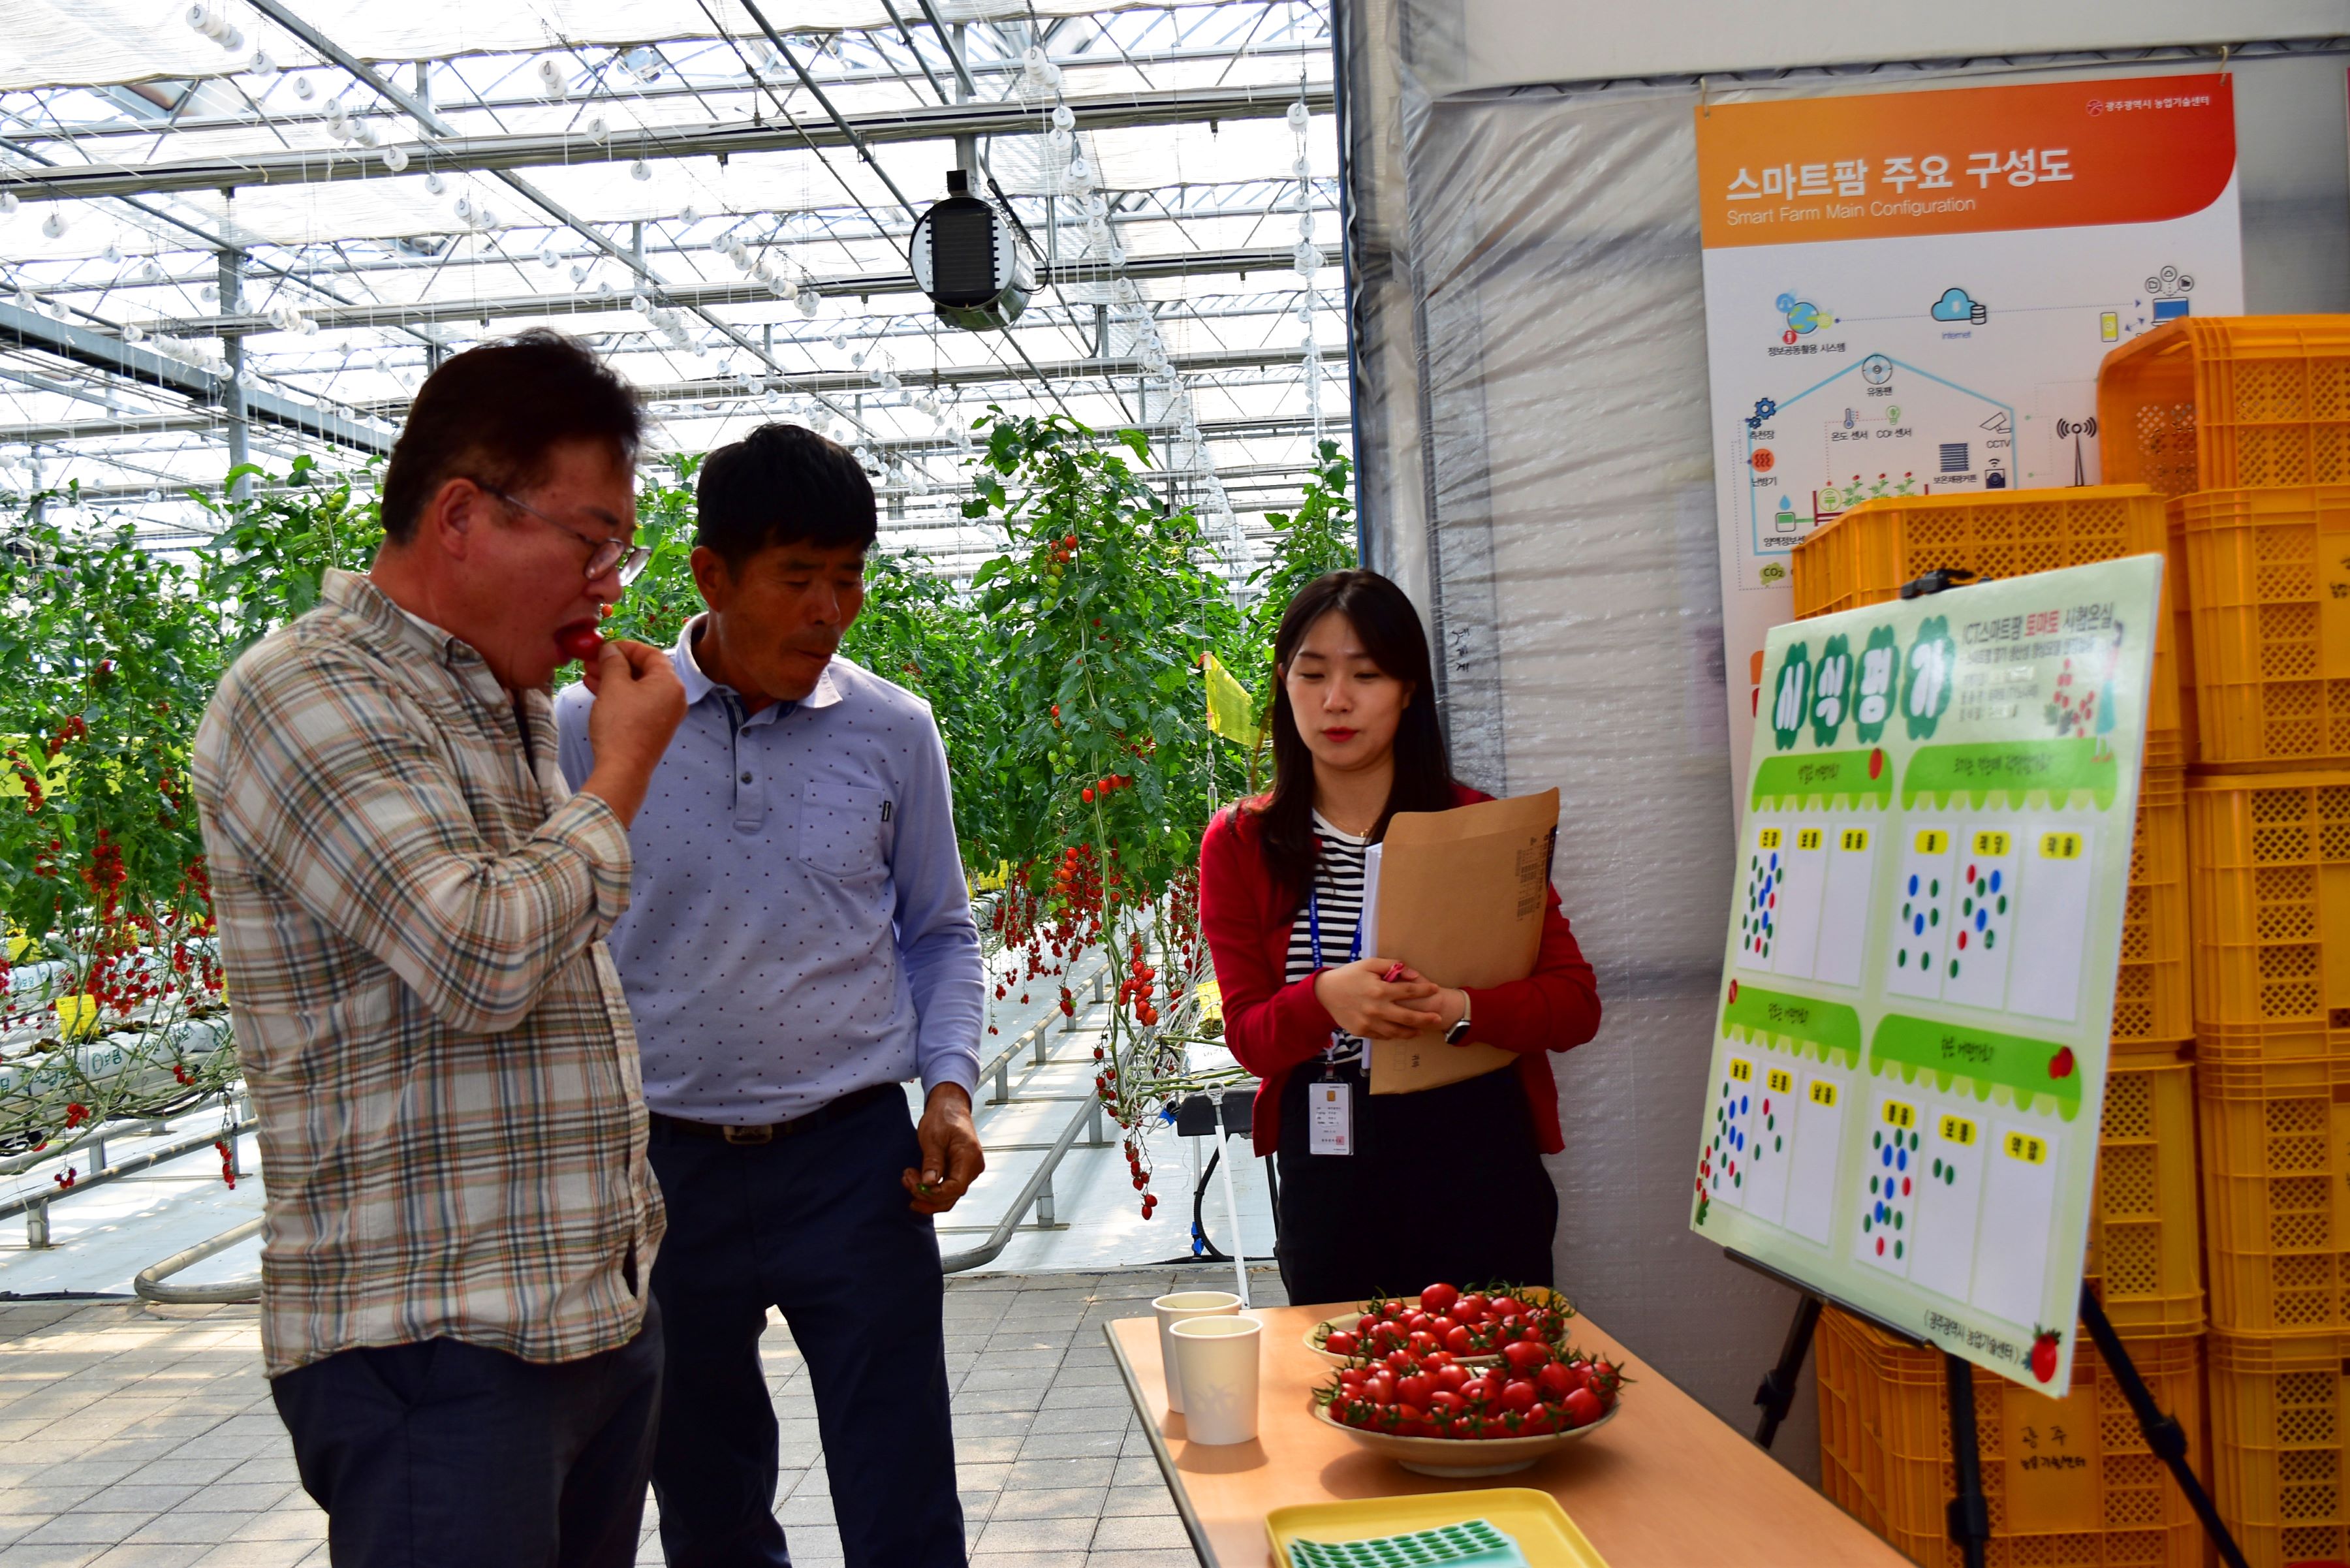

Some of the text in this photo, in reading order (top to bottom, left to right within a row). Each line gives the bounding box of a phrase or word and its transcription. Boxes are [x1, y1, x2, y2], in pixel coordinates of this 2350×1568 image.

[2105, 95, 2210, 112] 광주광역시 농업기술센터
[1726, 148, 2075, 201] 스마트팜 주요 구성도
[1727, 197, 1976, 226] Smart Farm Main Configuration
[1820, 343, 1846, 353] 시스템
[1866, 386, 1892, 397] 유동팬
[1831, 430, 1868, 442] 온도 센서
[1895, 428, 1913, 438] 센서
[1986, 439, 2011, 449] CCTV
[1751, 477, 1777, 487] 난방기
